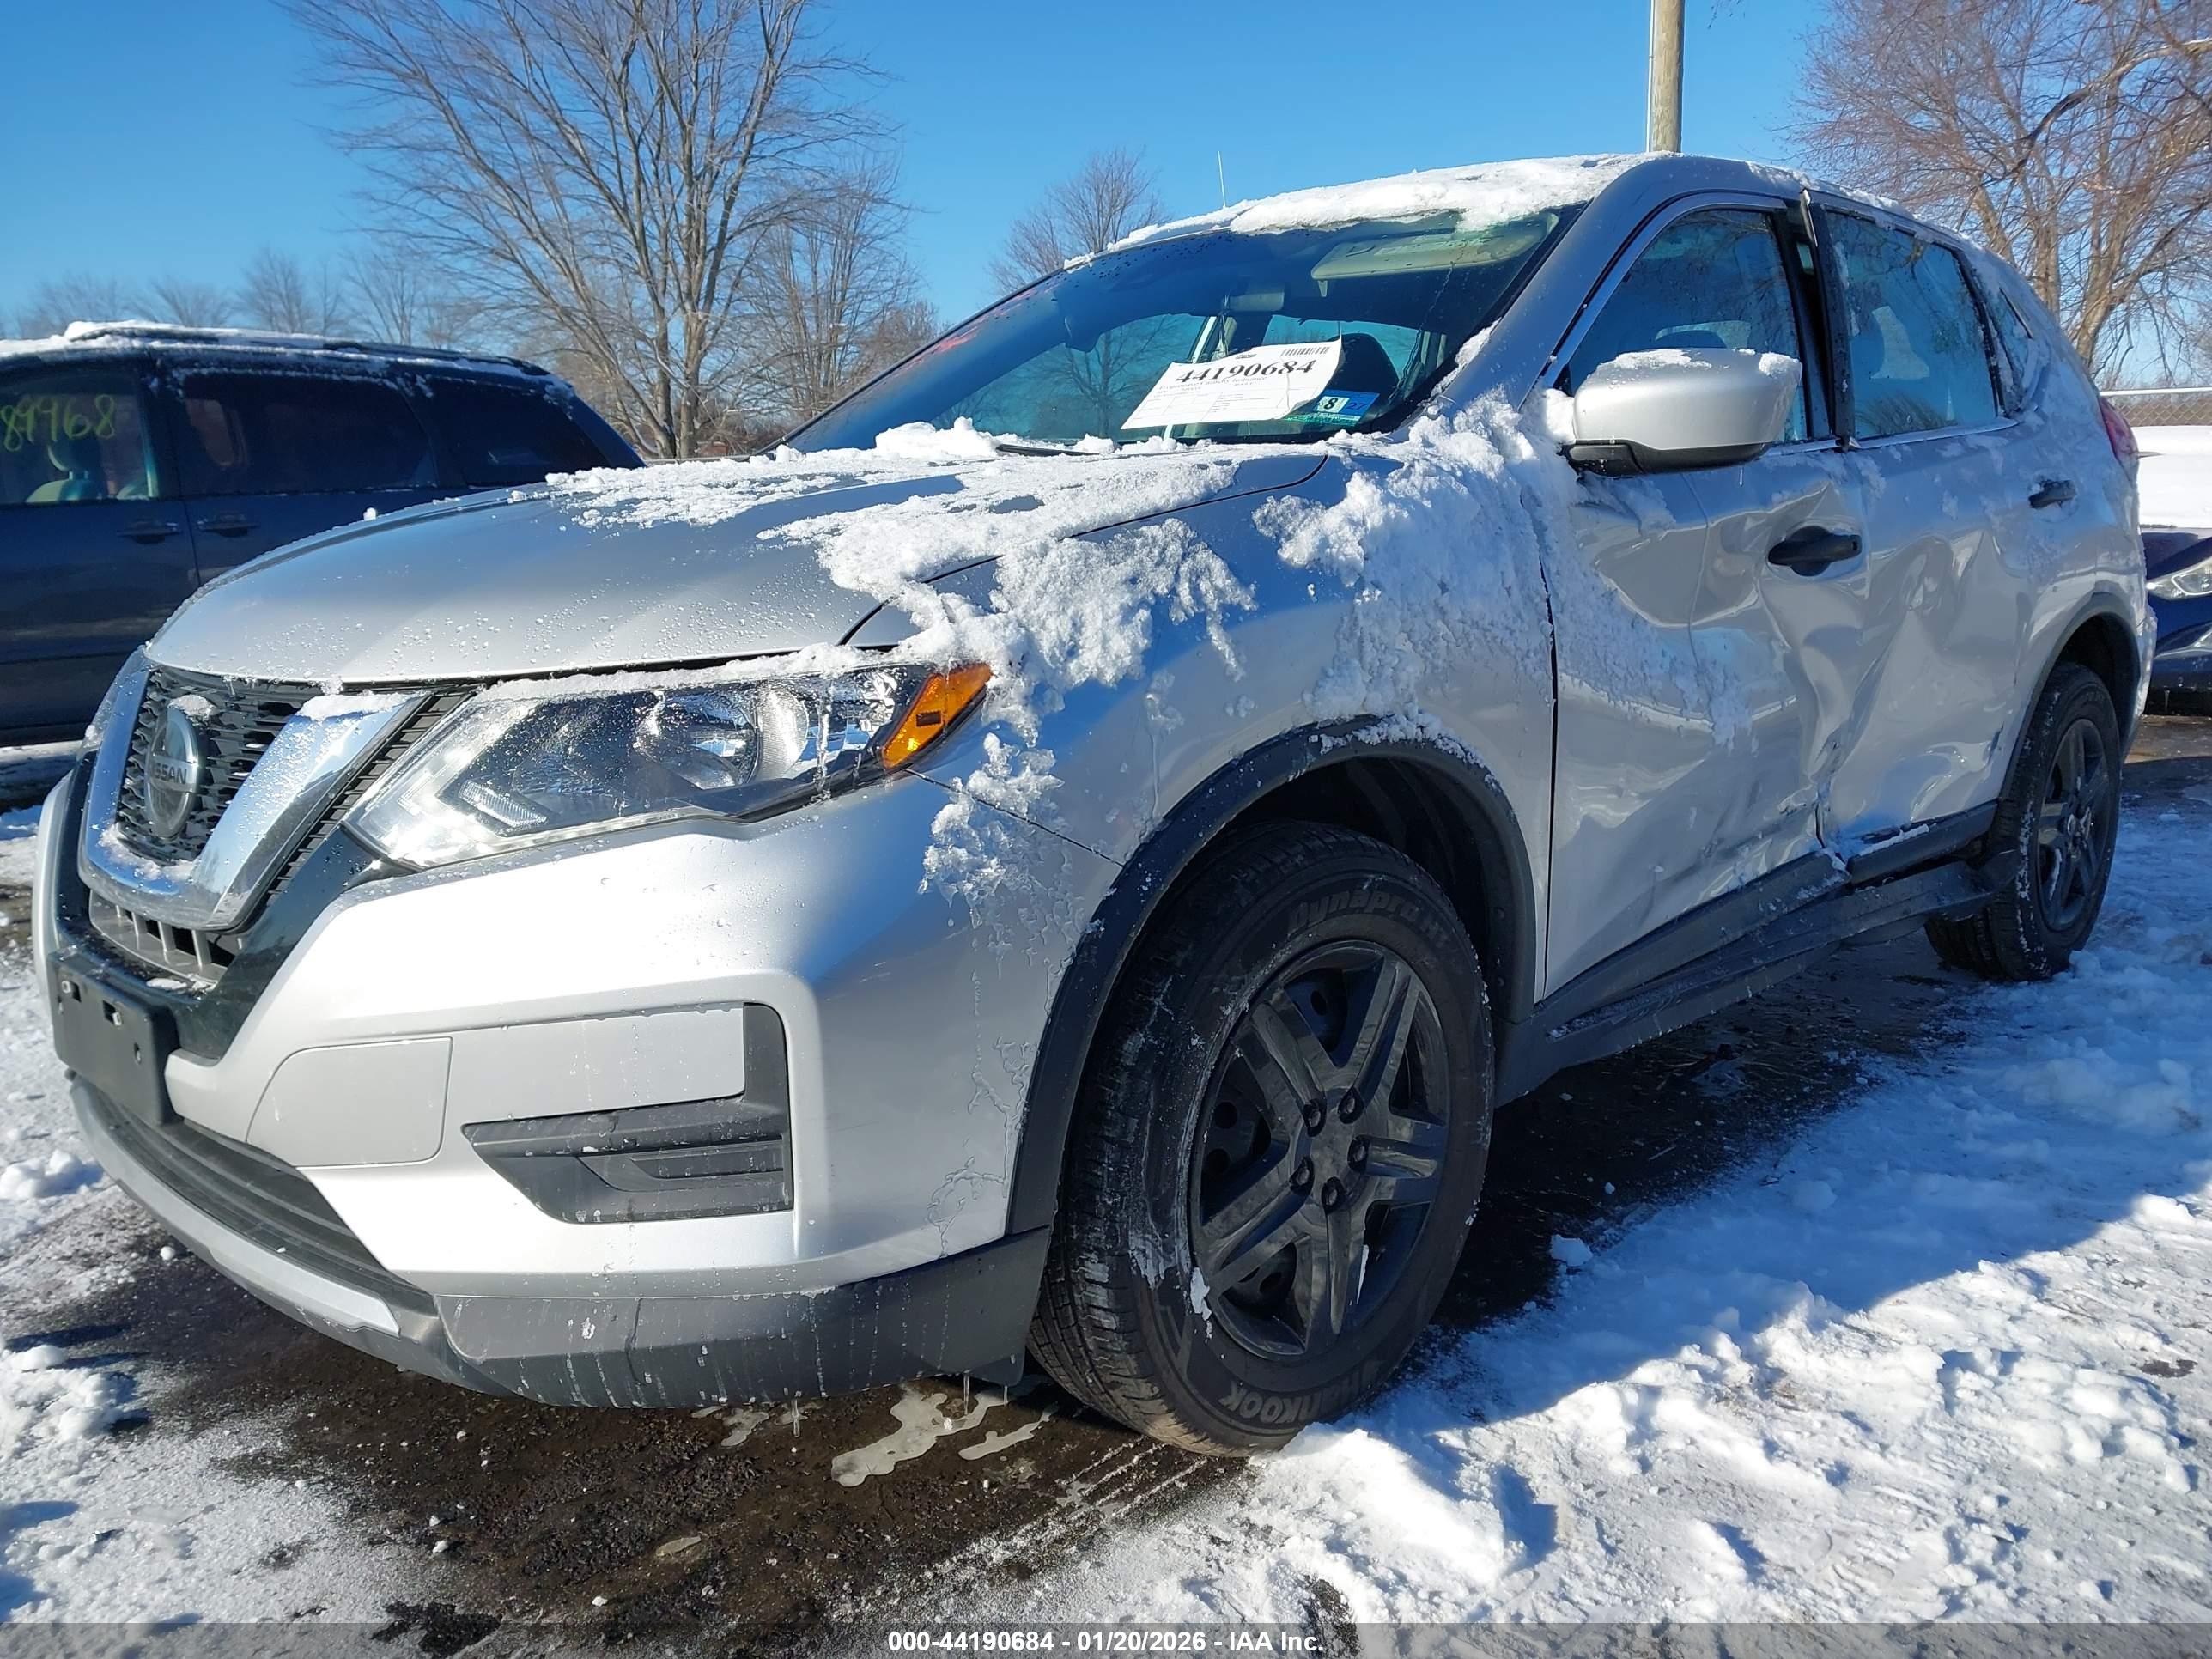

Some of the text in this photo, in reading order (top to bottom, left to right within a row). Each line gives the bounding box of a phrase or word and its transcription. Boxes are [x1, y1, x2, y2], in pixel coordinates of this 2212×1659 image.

[1176, 359, 1317, 383] 44190684
[1323, 398, 1339, 410] 8
[149, 759, 188, 785] SSAN
